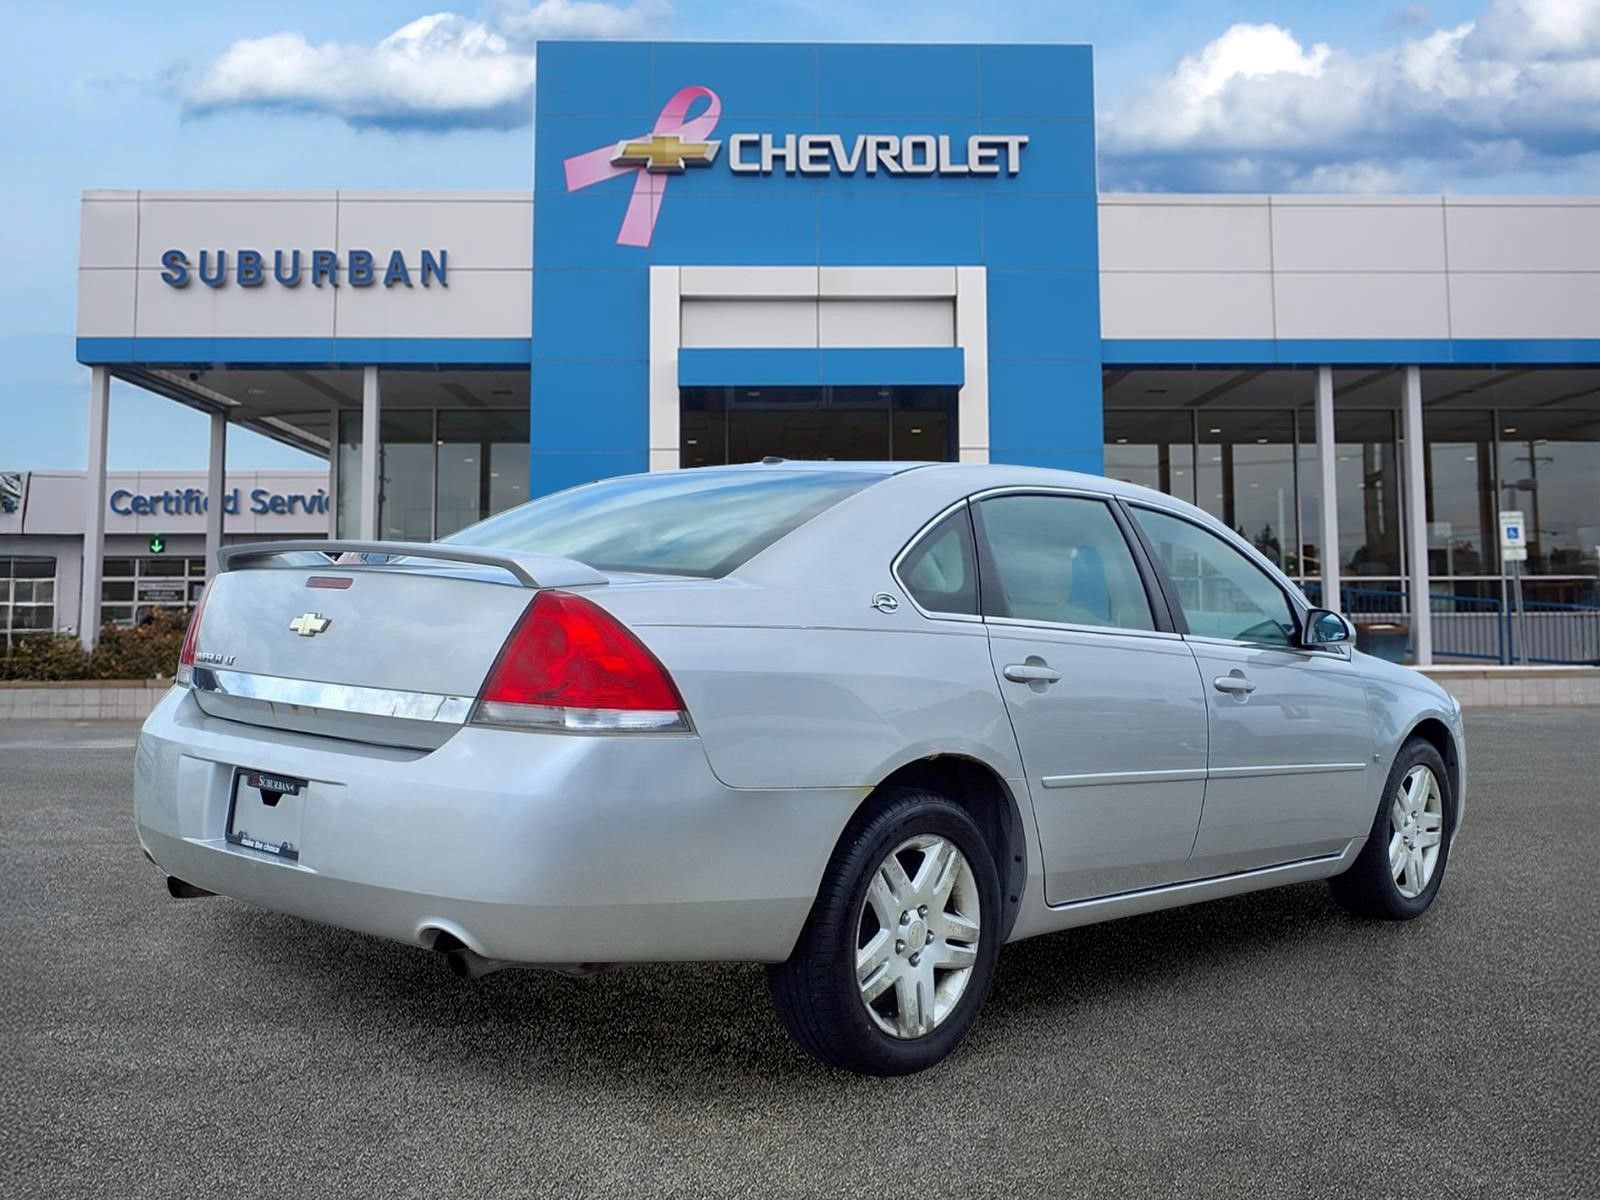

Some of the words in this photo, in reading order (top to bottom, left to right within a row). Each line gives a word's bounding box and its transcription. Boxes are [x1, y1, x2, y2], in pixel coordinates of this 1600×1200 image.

[729, 133, 1030, 175] CHEVROLET
[161, 249, 449, 288] SUBURBAN
[110, 488, 240, 516] Certifid
